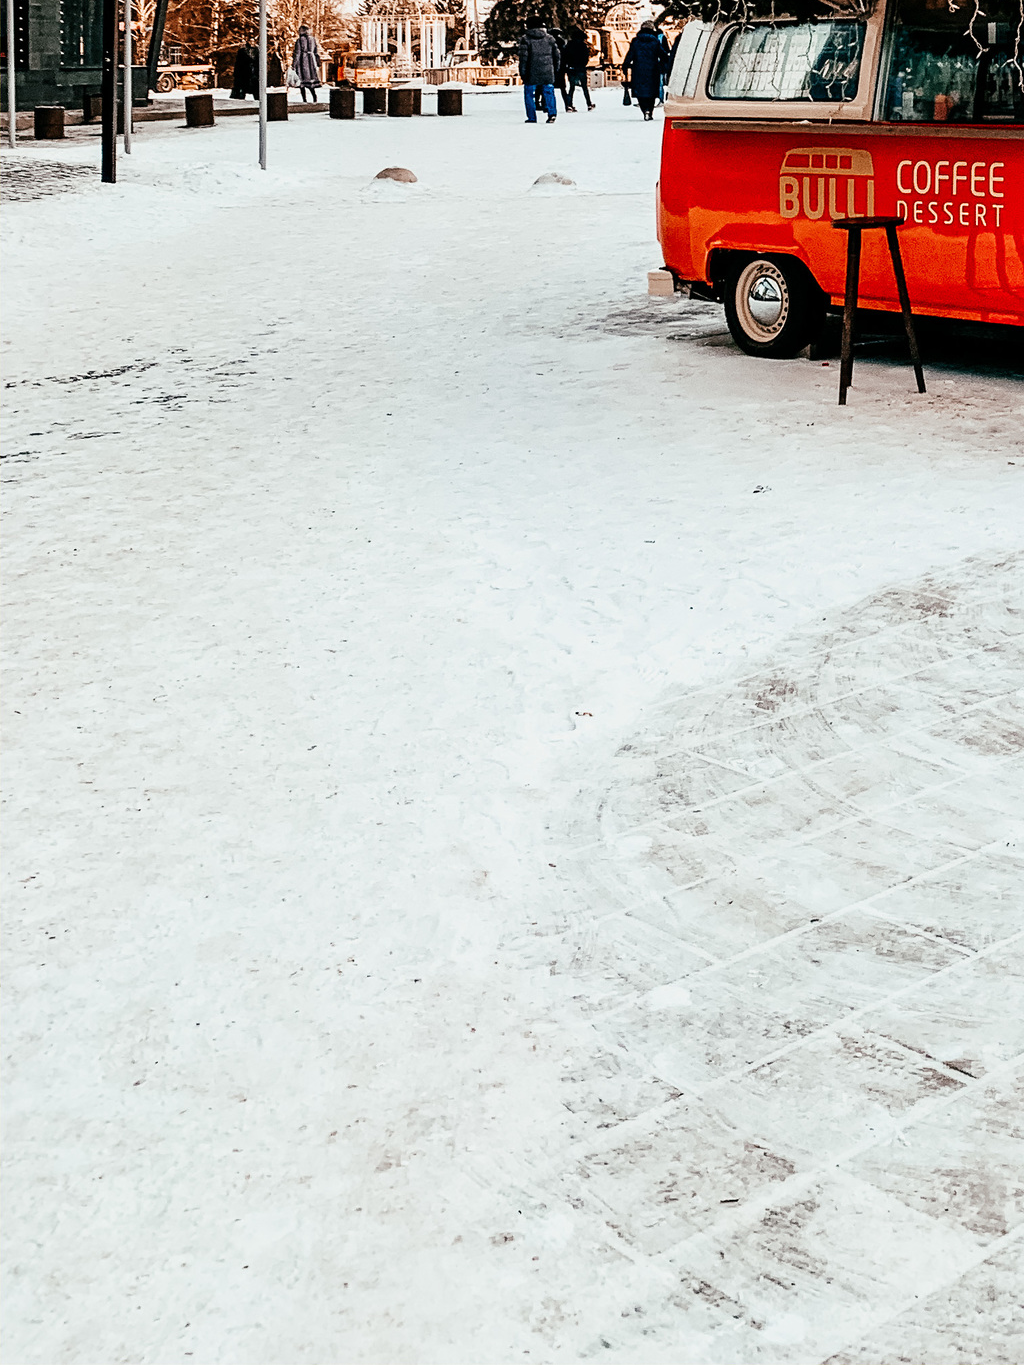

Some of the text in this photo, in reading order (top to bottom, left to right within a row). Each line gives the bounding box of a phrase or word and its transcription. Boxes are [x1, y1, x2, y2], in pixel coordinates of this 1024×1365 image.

[896, 160, 1005, 197] COFFEE
[779, 175, 874, 220] BULLI
[896, 200, 1004, 227] DESSERT
